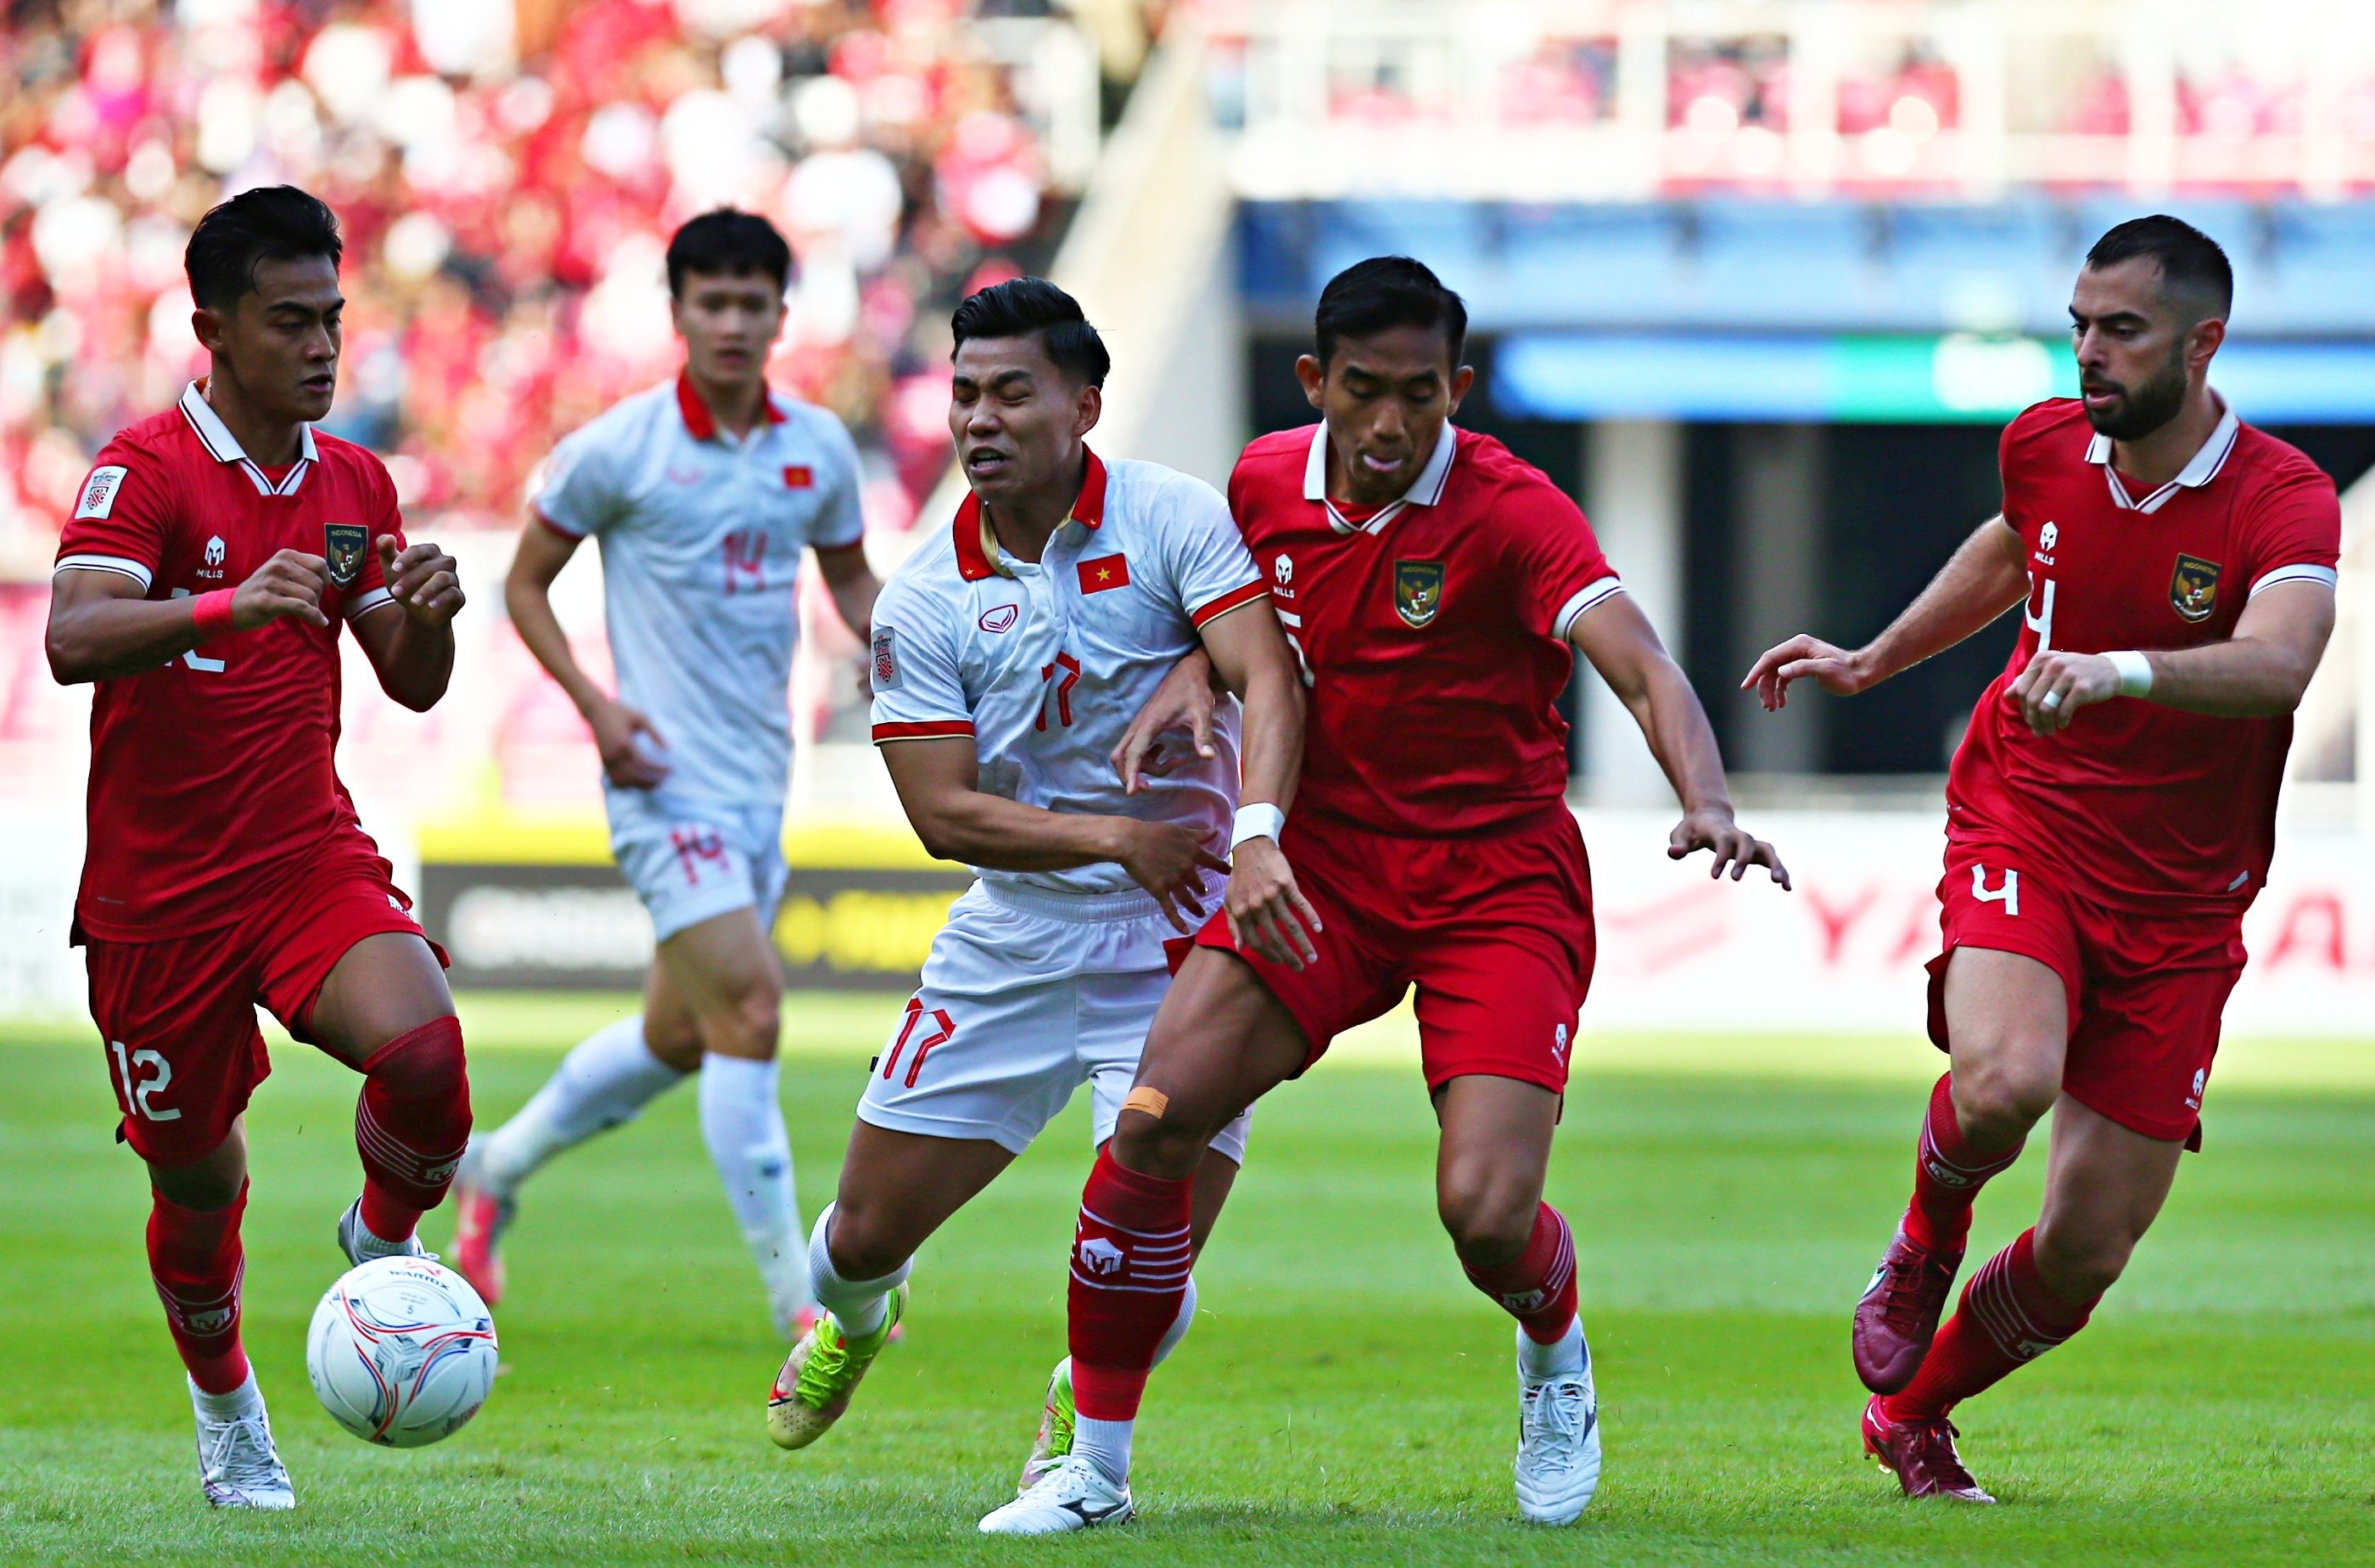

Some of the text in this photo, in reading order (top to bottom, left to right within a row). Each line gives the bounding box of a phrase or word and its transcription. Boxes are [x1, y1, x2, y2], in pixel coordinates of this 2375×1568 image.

[331, 529, 362, 538] INDONESIA
[723, 528, 768, 596] 14
[196, 568, 223, 579] MILLS
[1273, 585, 1295, 599] MILLS
[2025, 569, 2056, 653] 4
[1035, 650, 1082, 732] 17
[669, 826, 733, 887] 14
[1971, 863, 2019, 916] 4
[882, 997, 957, 1089] 17
[111, 1040, 182, 1121] 12
[389, 1269, 450, 1291] WARRIX
